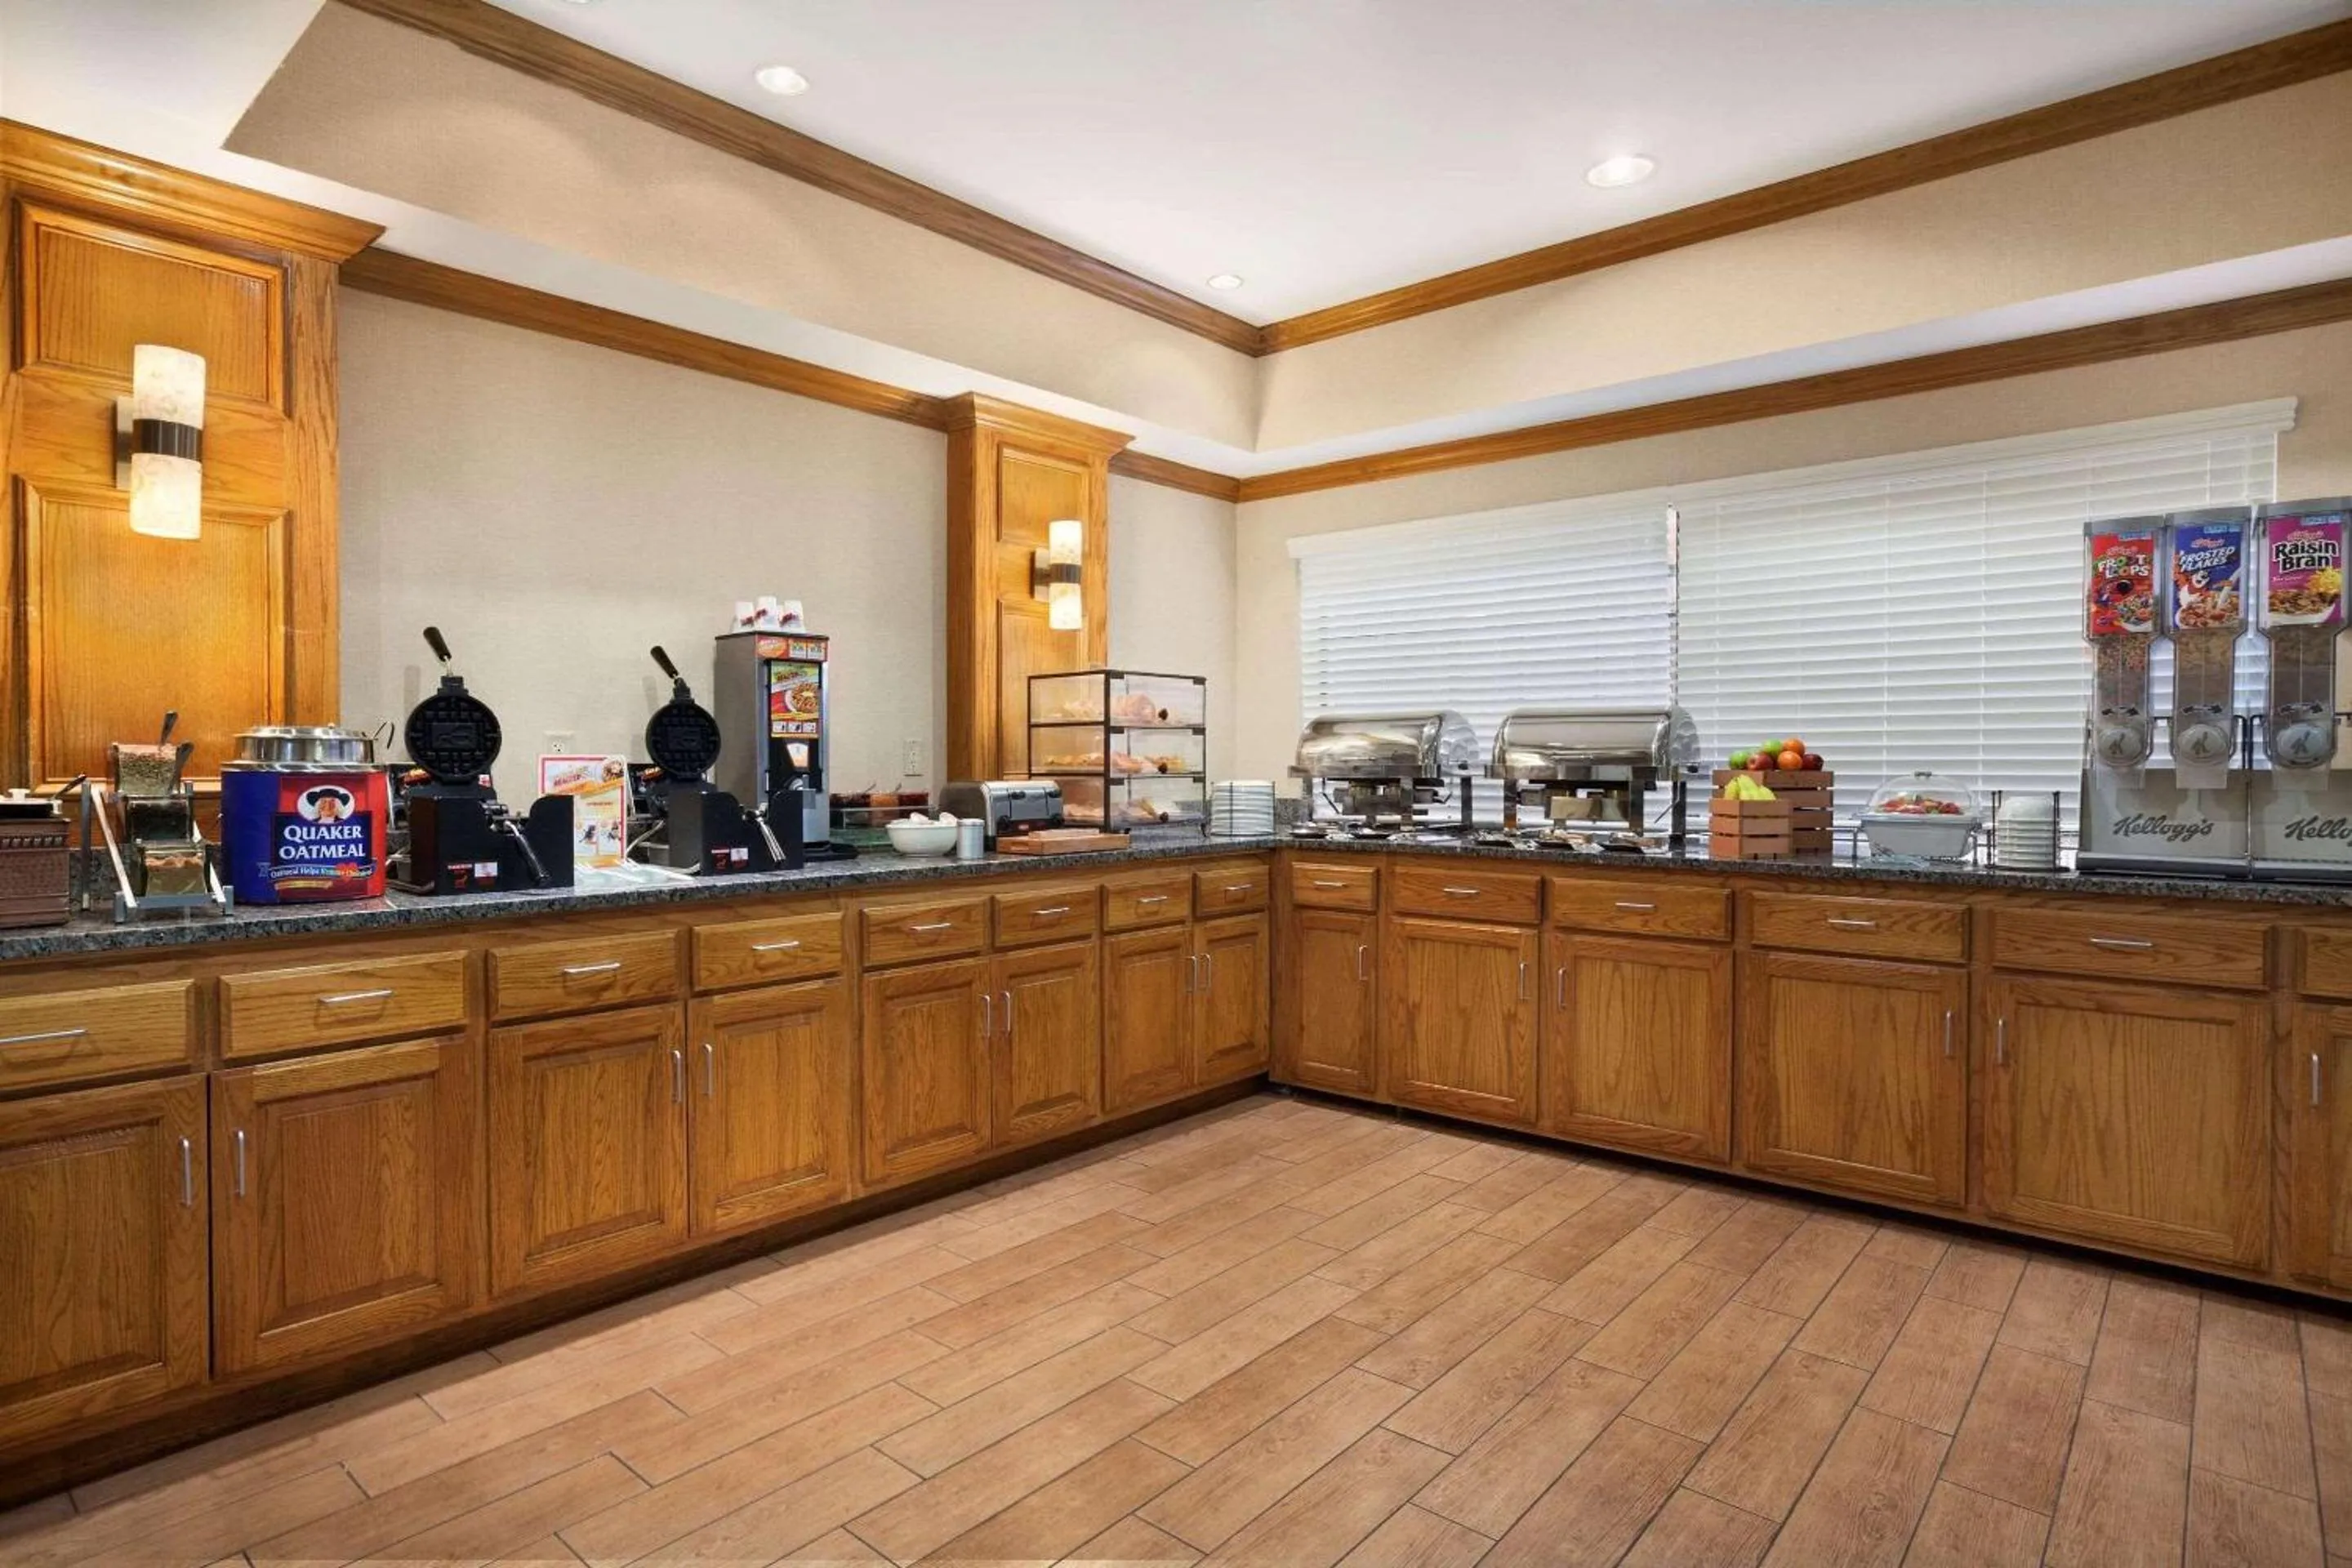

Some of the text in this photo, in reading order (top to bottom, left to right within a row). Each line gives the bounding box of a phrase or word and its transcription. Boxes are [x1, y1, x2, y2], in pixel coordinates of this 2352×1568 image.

[2180, 546, 2235, 565] FROSTED
[2274, 541, 2338, 560] Raisin
[2181, 557, 2228, 572] FLAKES
[2281, 555, 2331, 571] Bran
[283, 825, 363, 843] QUAKER
[2112, 813, 2214, 842] Kellogg's
[2284, 815, 2352, 847] Kello
[278, 844, 367, 860] OATMEAL
